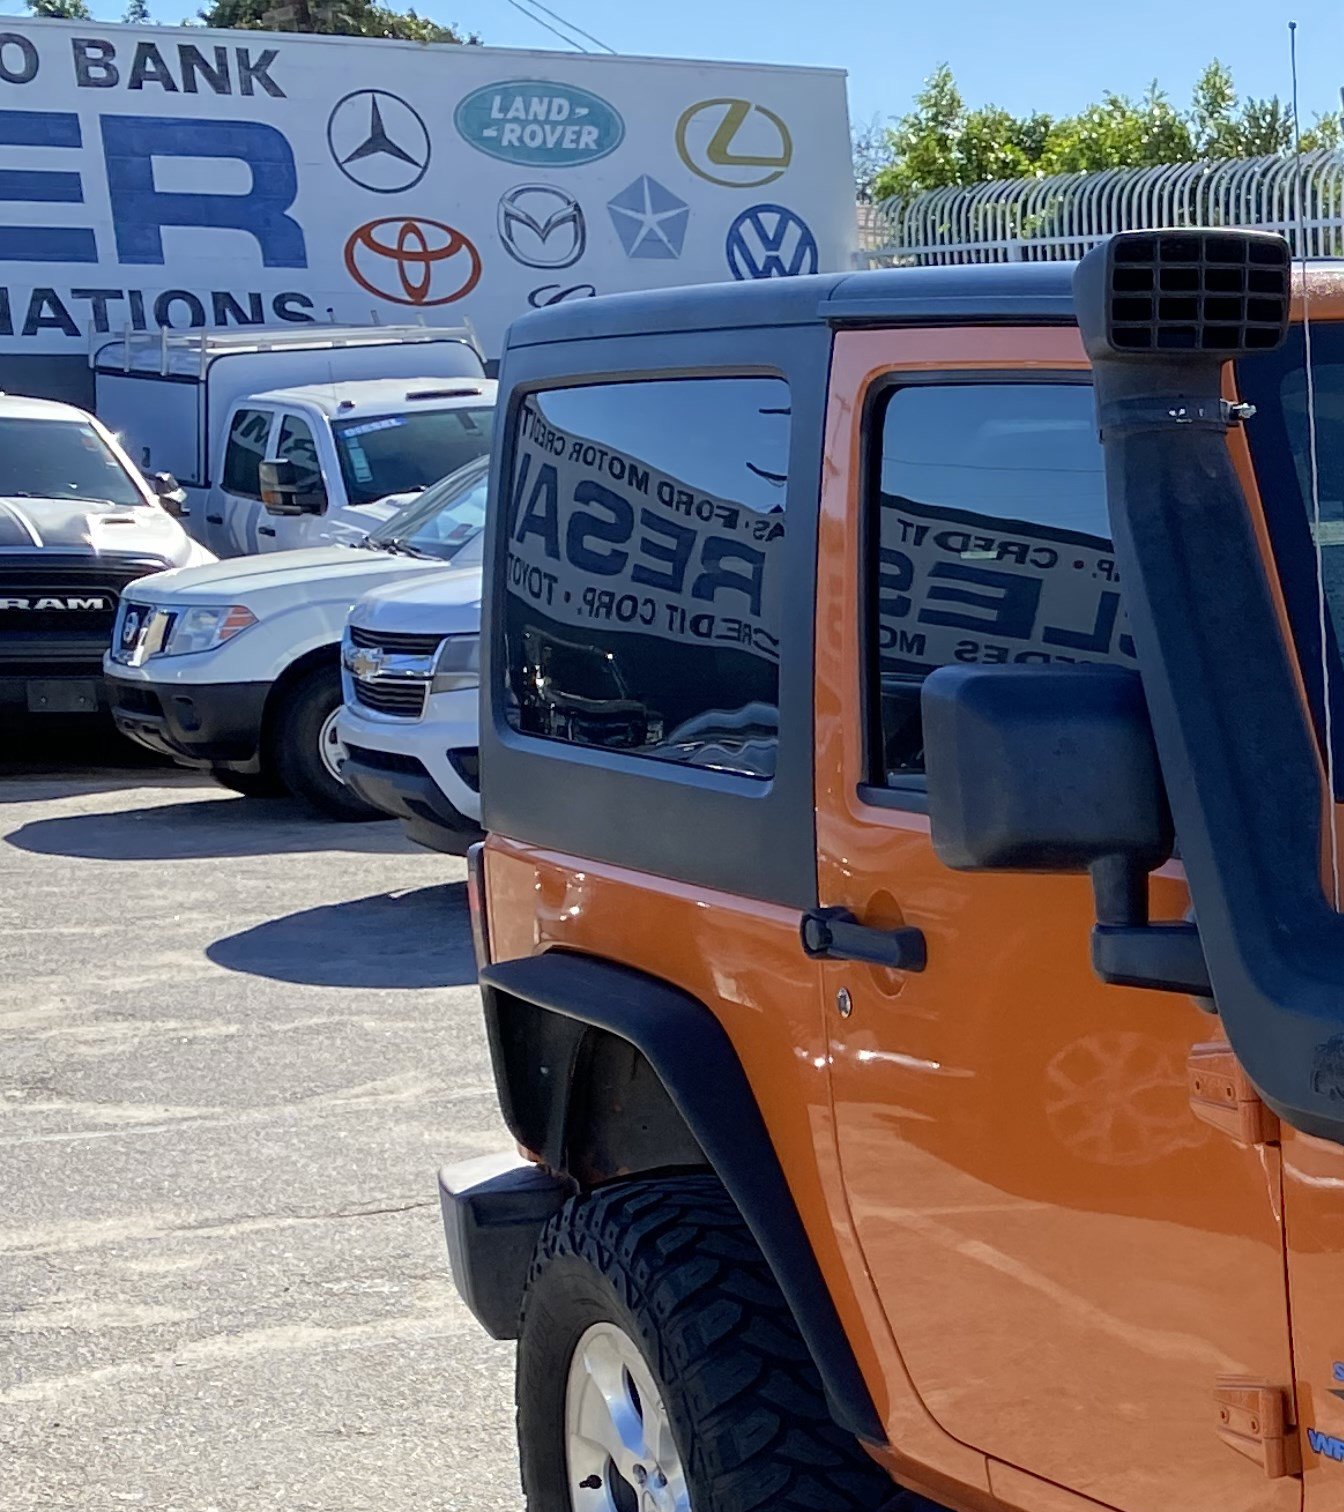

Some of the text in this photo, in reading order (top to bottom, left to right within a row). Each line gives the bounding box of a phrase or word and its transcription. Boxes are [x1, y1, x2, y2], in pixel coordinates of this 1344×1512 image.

[71, 37, 288, 99] BANK
[491, 95, 570, 121] LAND
[501, 123, 600, 150] ROVER
[0, 597, 104, 610] RAM
